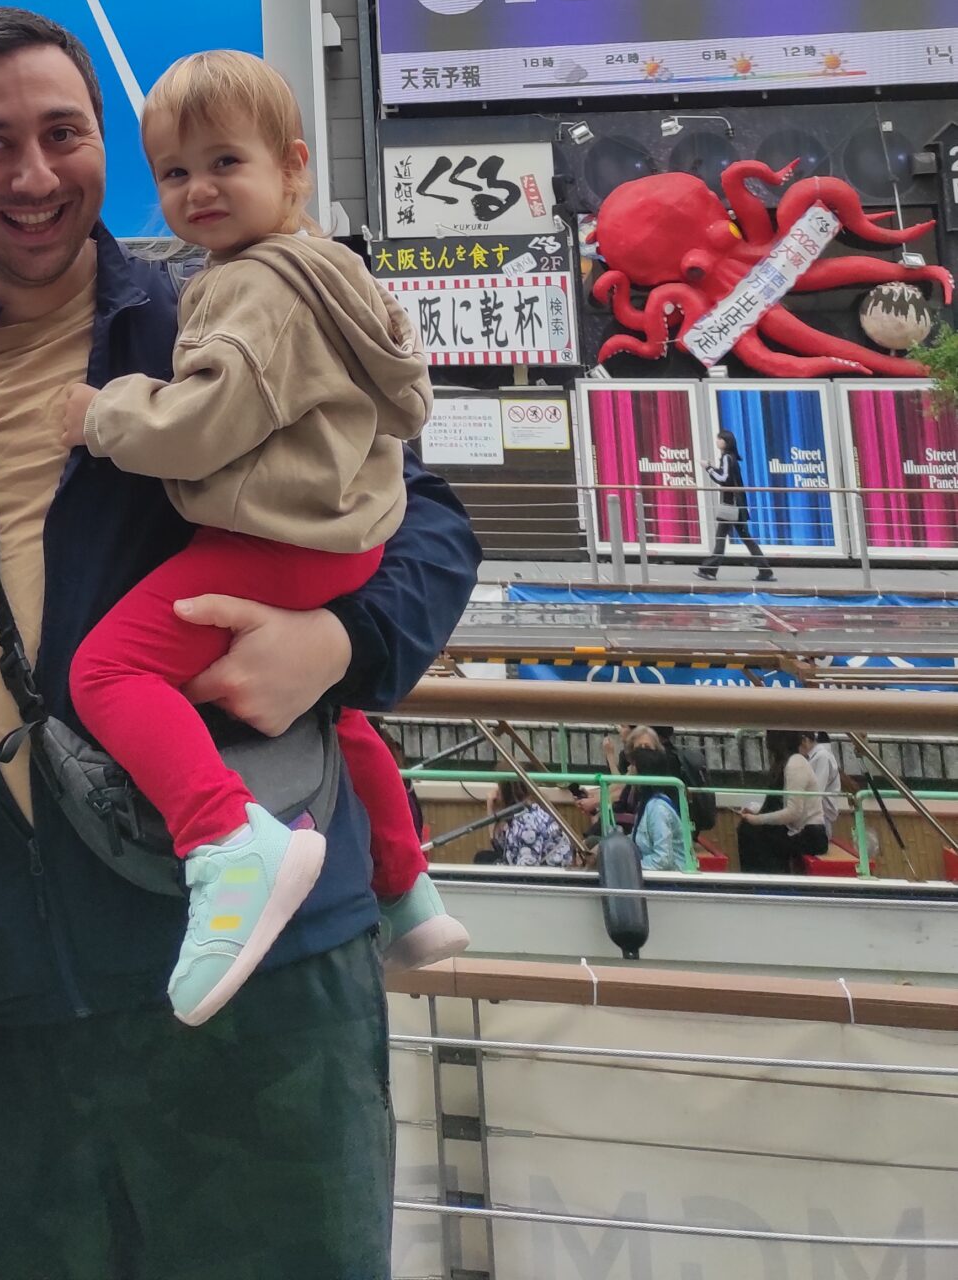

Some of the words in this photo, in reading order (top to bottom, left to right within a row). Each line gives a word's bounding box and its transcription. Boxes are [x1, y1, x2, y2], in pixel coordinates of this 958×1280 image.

[605, 52, 639, 65] 24時
[702, 49, 727, 61] 6時
[783, 45, 816, 58] 12時
[400, 66, 481, 89] 天気予報
[416, 155, 521, 221] くくる
[453, 223, 489, 231] KUKURU
[528, 236, 561, 254] くくる
[790, 228, 820, 256] 2025
[375, 243, 510, 272] 大阪もんを食す
[540, 256, 563, 271] 2F
[779, 244, 806, 269] 大阪
[395, 290, 543, 350] 阪に乾杯
[549, 297, 564, 336] 検索
[694, 291, 759, 355] 出店決定
[659, 445, 689, 460] Street
[791, 447, 821, 461] Street
[926, 447, 957, 462] Street
[794, 473, 828, 488] Panels.
